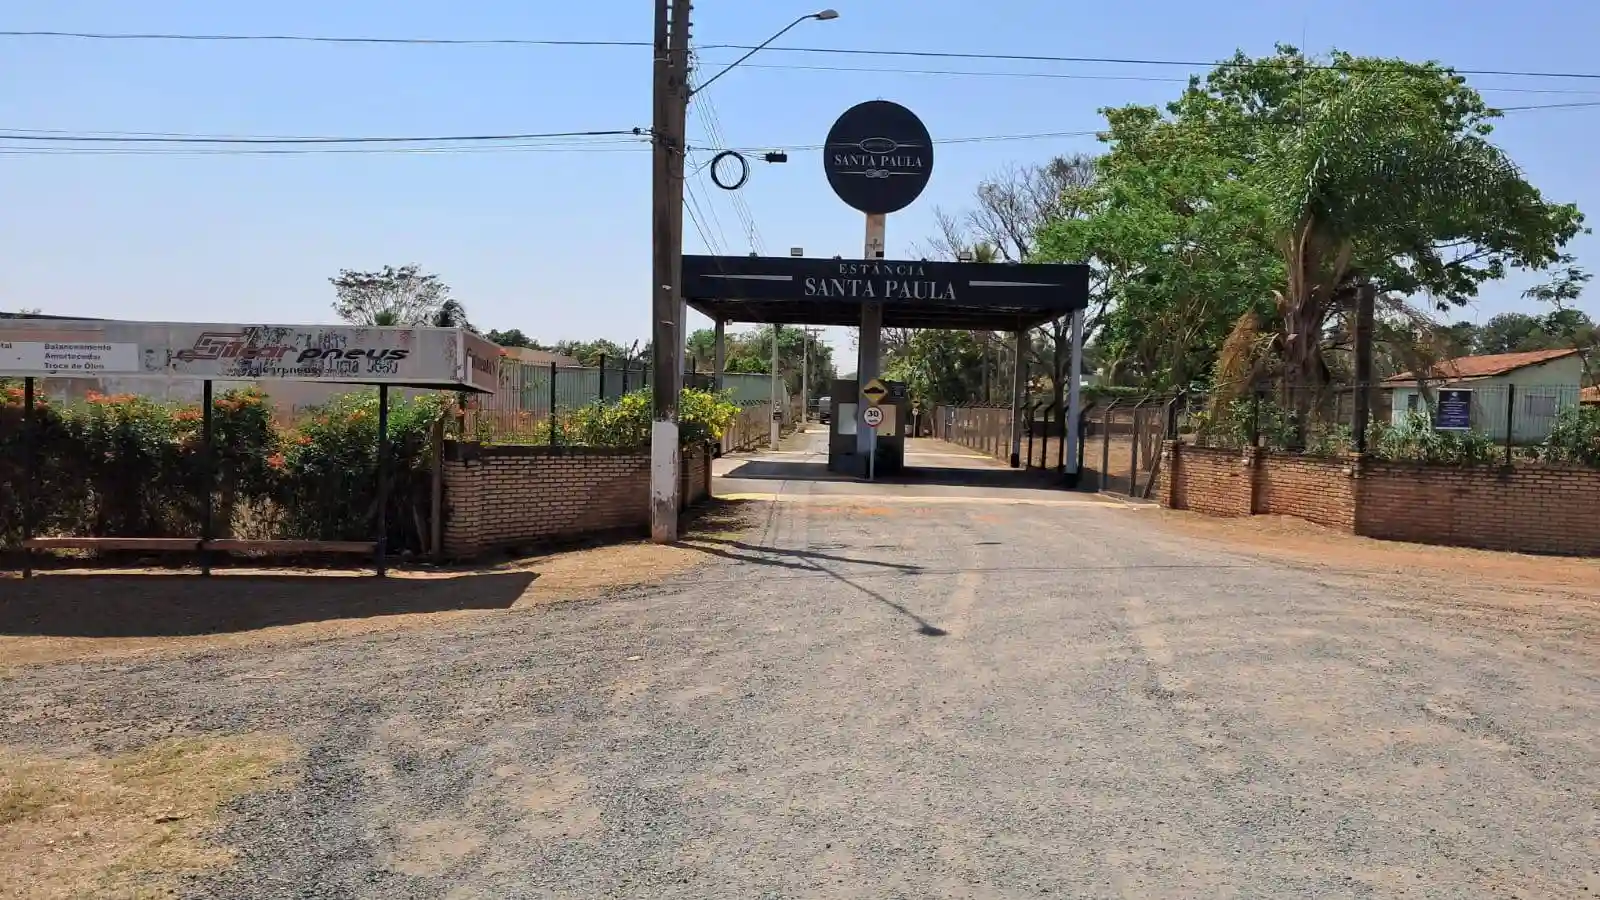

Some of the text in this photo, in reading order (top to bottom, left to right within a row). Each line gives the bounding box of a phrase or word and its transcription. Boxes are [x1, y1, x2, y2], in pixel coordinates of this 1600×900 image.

[834, 154, 923, 167] SANTA PAULA
[839, 262, 925, 276] ESTÂNCIA
[804, 277, 957, 300] SANTA PAULA
[296, 347, 410, 363] pneus
[44, 362, 69, 370] Troca
[71, 362, 82, 370] de
[867, 410, 879, 418] 30
